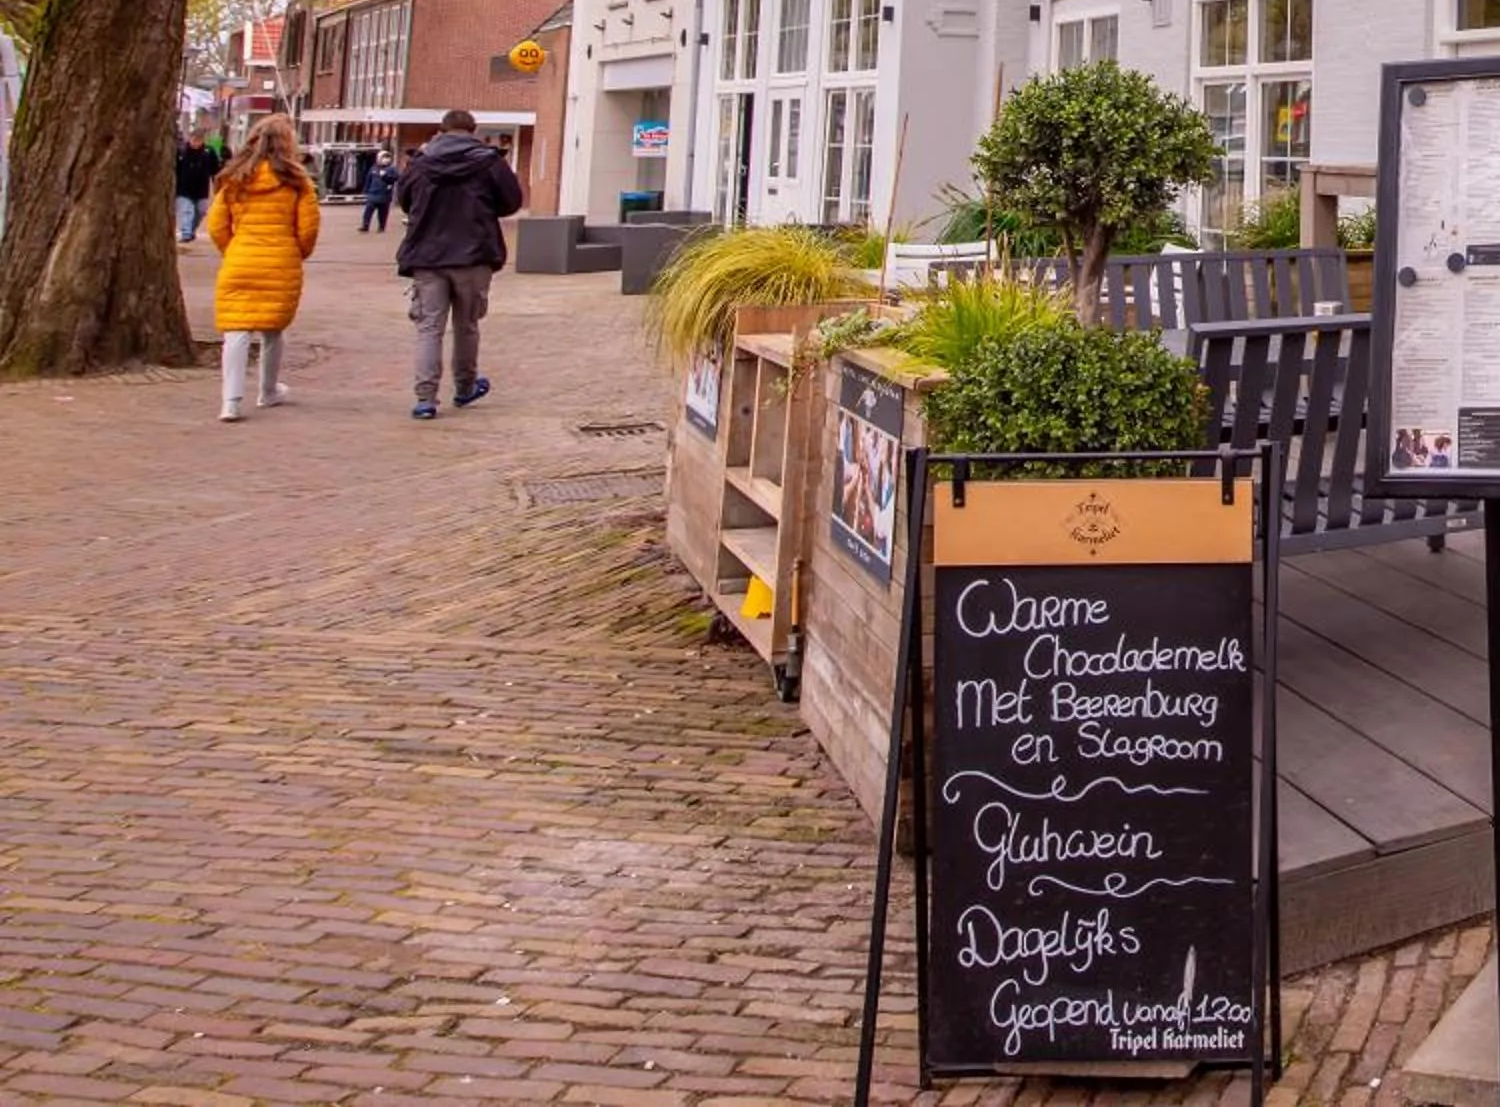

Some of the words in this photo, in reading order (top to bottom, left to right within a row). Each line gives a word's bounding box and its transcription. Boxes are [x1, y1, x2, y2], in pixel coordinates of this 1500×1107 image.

[956, 679, 1033, 729] Met
[1011, 734, 1059, 765] en
[990, 979, 1119, 1056] Geopend
[1110, 1029, 1157, 1057] Tripel
